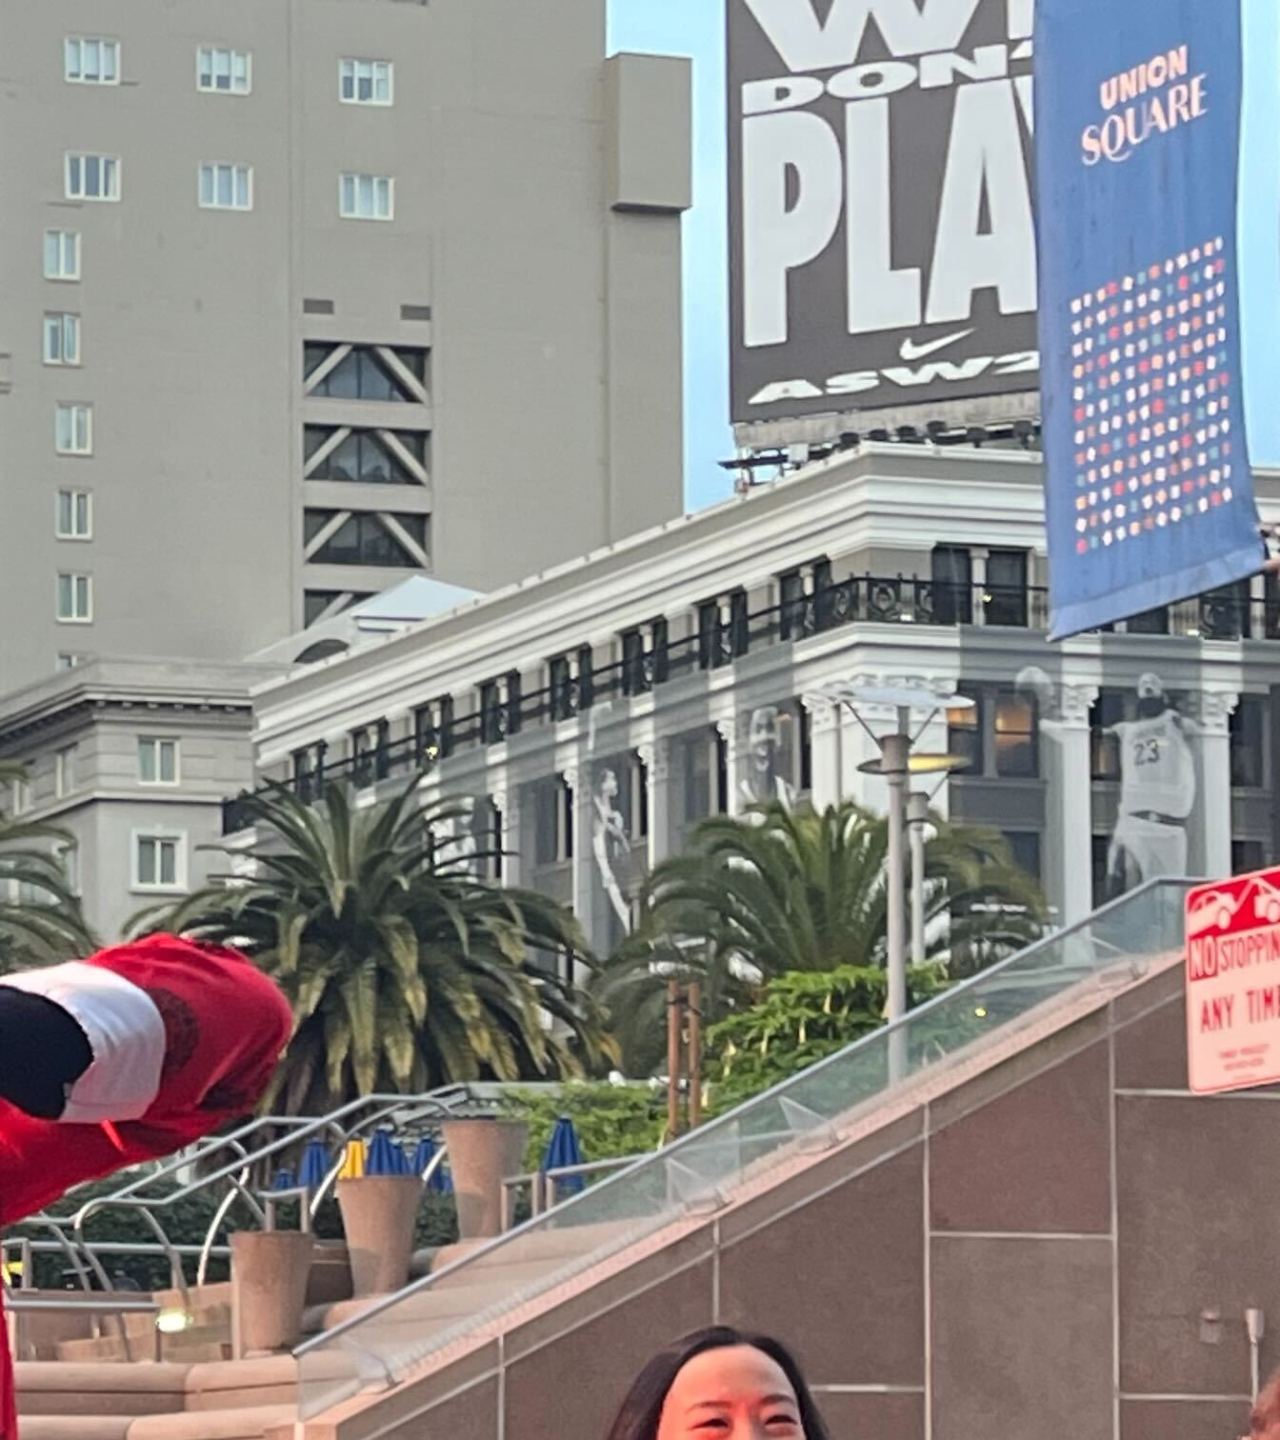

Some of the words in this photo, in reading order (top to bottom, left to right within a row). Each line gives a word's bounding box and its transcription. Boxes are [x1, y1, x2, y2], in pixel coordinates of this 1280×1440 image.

[745, 0, 1034, 73] W
[1100, 44, 1187, 111] UNION
[1080, 72, 1208, 166] SQUARE
[741, 75, 1038, 348] PLA
[1134, 739, 1160, 766] 23
[1190, 935, 1217, 980] NO
[1201, 994, 1234, 1034] ANY
[1247, 984, 1280, 1024] TIM
